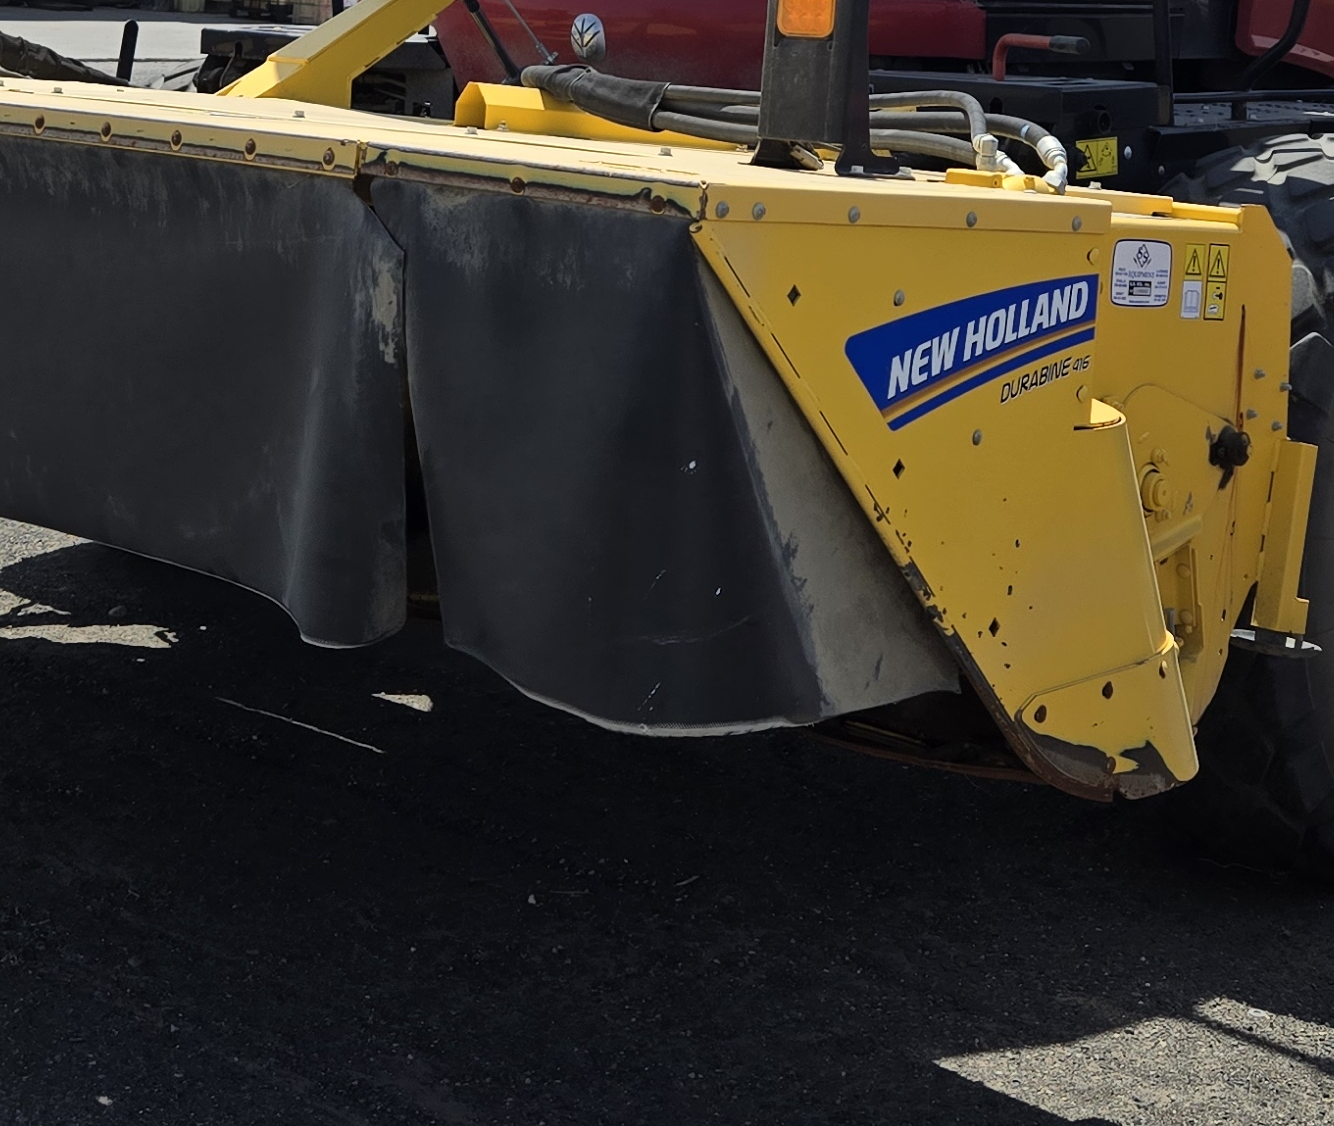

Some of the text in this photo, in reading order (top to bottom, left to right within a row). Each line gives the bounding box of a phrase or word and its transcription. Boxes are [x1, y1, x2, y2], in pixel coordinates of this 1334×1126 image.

[1128, 270, 1155, 279] EQUIPMENT
[886, 280, 1089, 400] NEW HOLLAND
[1000, 355, 1091, 404] DURABINE 416
